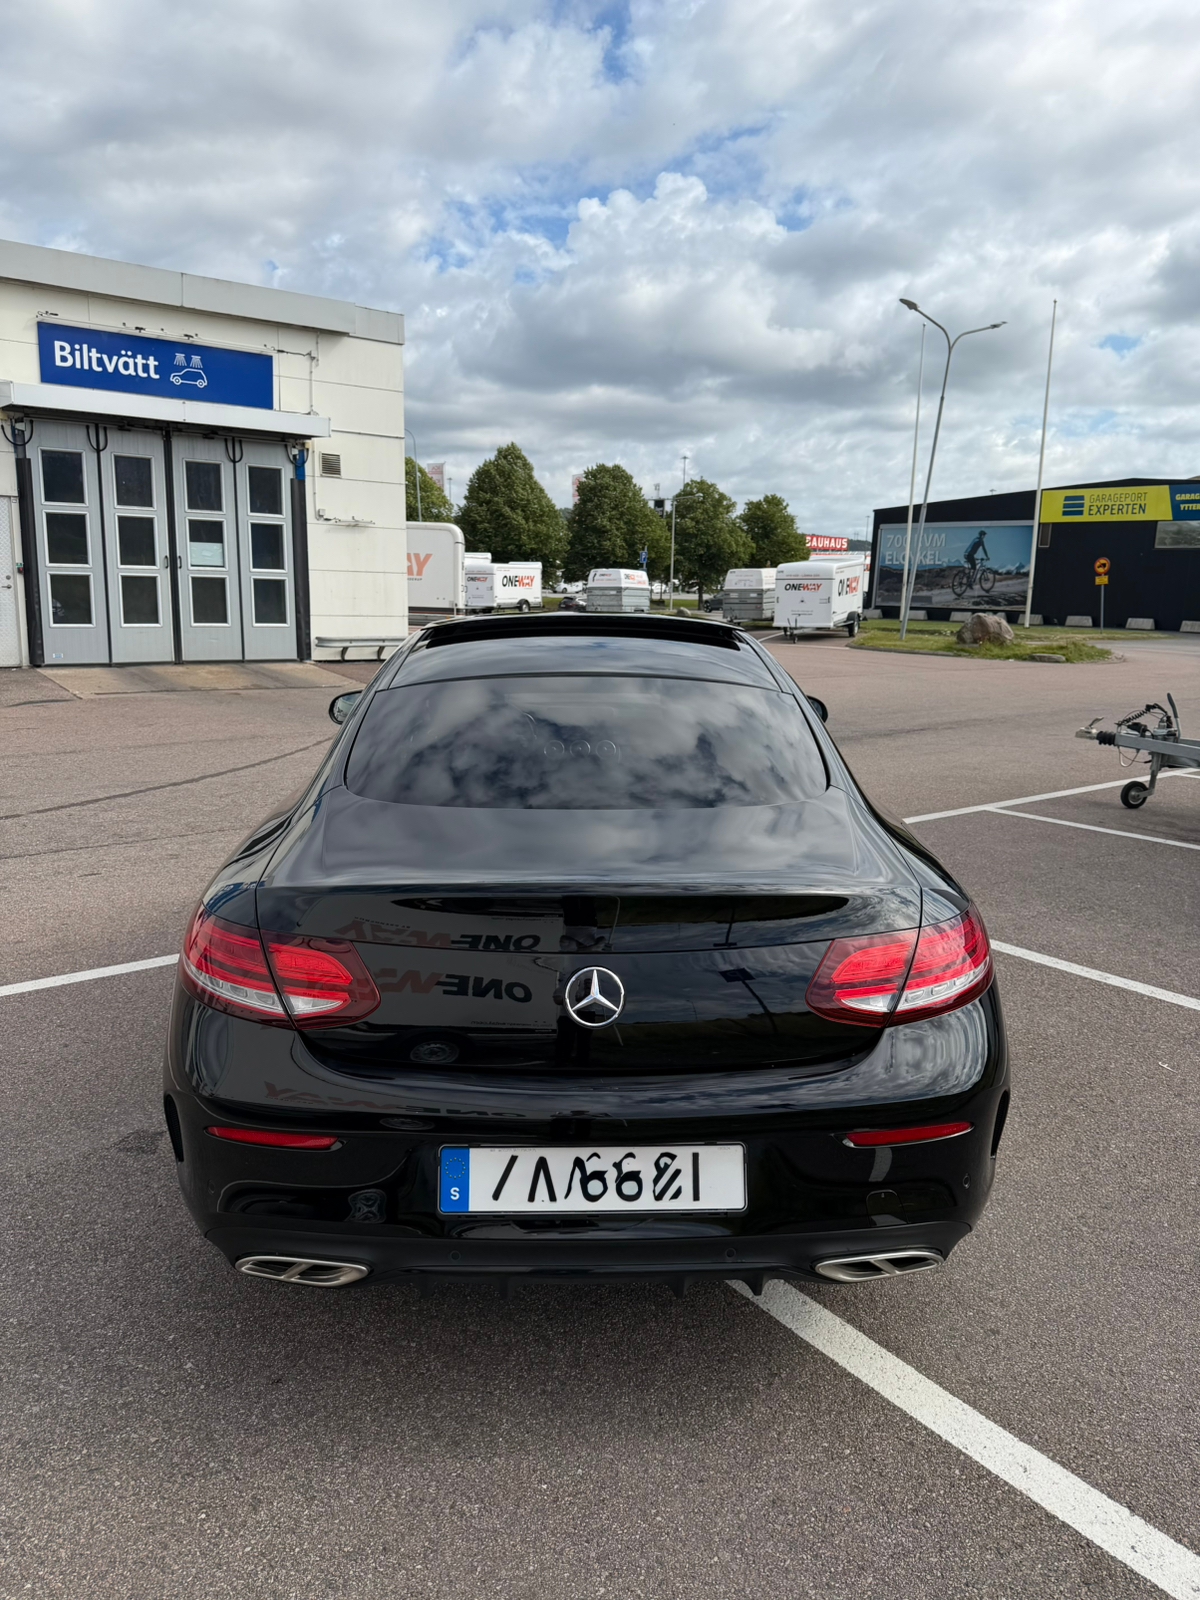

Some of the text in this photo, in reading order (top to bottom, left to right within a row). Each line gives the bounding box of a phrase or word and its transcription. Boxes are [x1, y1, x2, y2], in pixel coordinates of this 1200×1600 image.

[54, 340, 160, 379] Biltvätt
[1089, 491, 1148, 504] GARAGEPORT
[1088, 503, 1147, 516] EXPERTEN
[805, 535, 848, 549] BAUHAUS
[501, 575, 535, 588] ONEWAY
[784, 583, 822, 592] ONEWAY
[450, 1187, 460, 1200] S
